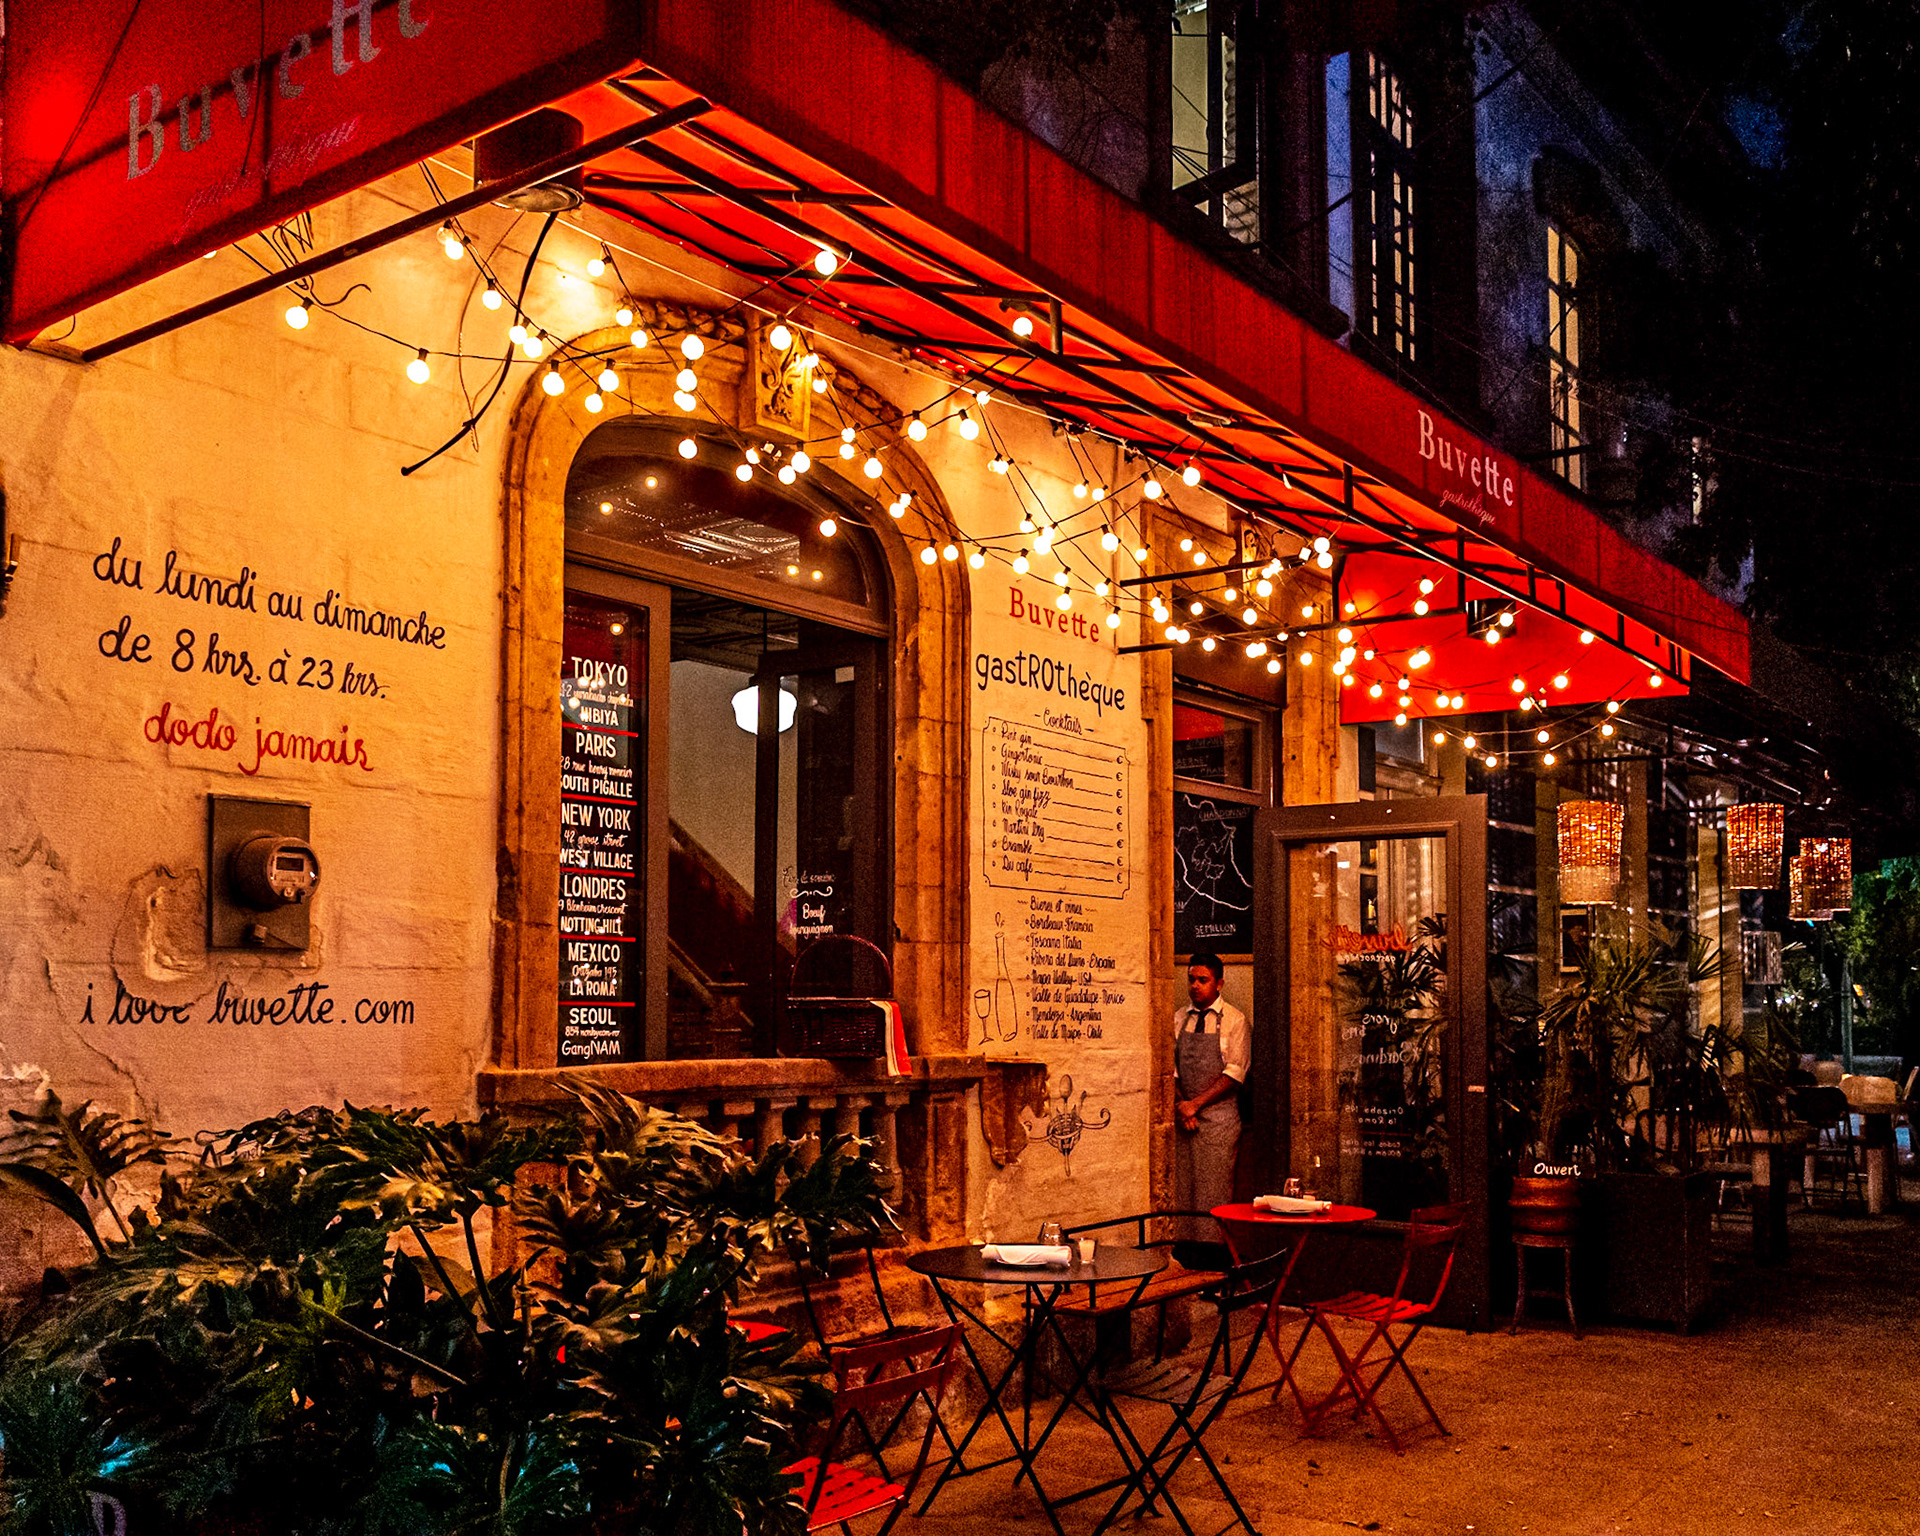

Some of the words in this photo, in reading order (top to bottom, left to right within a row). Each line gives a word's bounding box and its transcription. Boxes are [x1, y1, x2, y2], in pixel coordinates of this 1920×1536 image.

[1418, 409, 1514, 507] Buvette
[93, 537, 143, 590] du
[154, 550, 257, 613] lundi
[268, 590, 304, 622] au
[314, 589, 446, 650] dimanche
[1009, 586, 1099, 643] Buvette
[99, 615, 152, 664] de
[171, 628, 195, 673] 8
[268, 648, 288, 685] à
[297, 656, 334, 690] 23
[571, 656, 628, 687] TOKYO
[976, 650, 1125, 717] gastROthèque
[579, 706, 619, 726] HIBIYA
[1043, 706, 1083, 736] Cocktails
[144, 702, 237, 752] dodo
[238, 716, 374, 775] jamais
[576, 732, 616, 757] PARIS
[1020, 731, 1032, 748] gin
[593, 779, 632, 798] PIGALLE
[1020, 785, 1032, 805] gin
[562, 803, 593, 826] NEW
[597, 806, 631, 831] YORK
[564, 830, 575, 843] 42
[1002, 817, 1029, 836] Martini
[1032, 821, 1044, 843] Dry
[560, 848, 590, 868] WEST
[594, 850, 633, 870] VILLAGE
[564, 875, 626, 900] LONDRES
[1055, 899, 1063, 913] et
[561, 916, 600, 934] NOTTING
[603, 917, 623, 935] HILL
[568, 942, 620, 962] MEXICO
[1055, 953, 1066, 966] del
[570, 980, 584, 996] LA
[586, 981, 615, 996] ROMA
[1078, 972, 1092, 986] USA
[1054, 989, 1062, 1003] de
[569, 1008, 616, 1025] SEOUL
[562, 1040, 620, 1059] GangNAM
[1533, 1162, 1581, 1176] Ouvert
